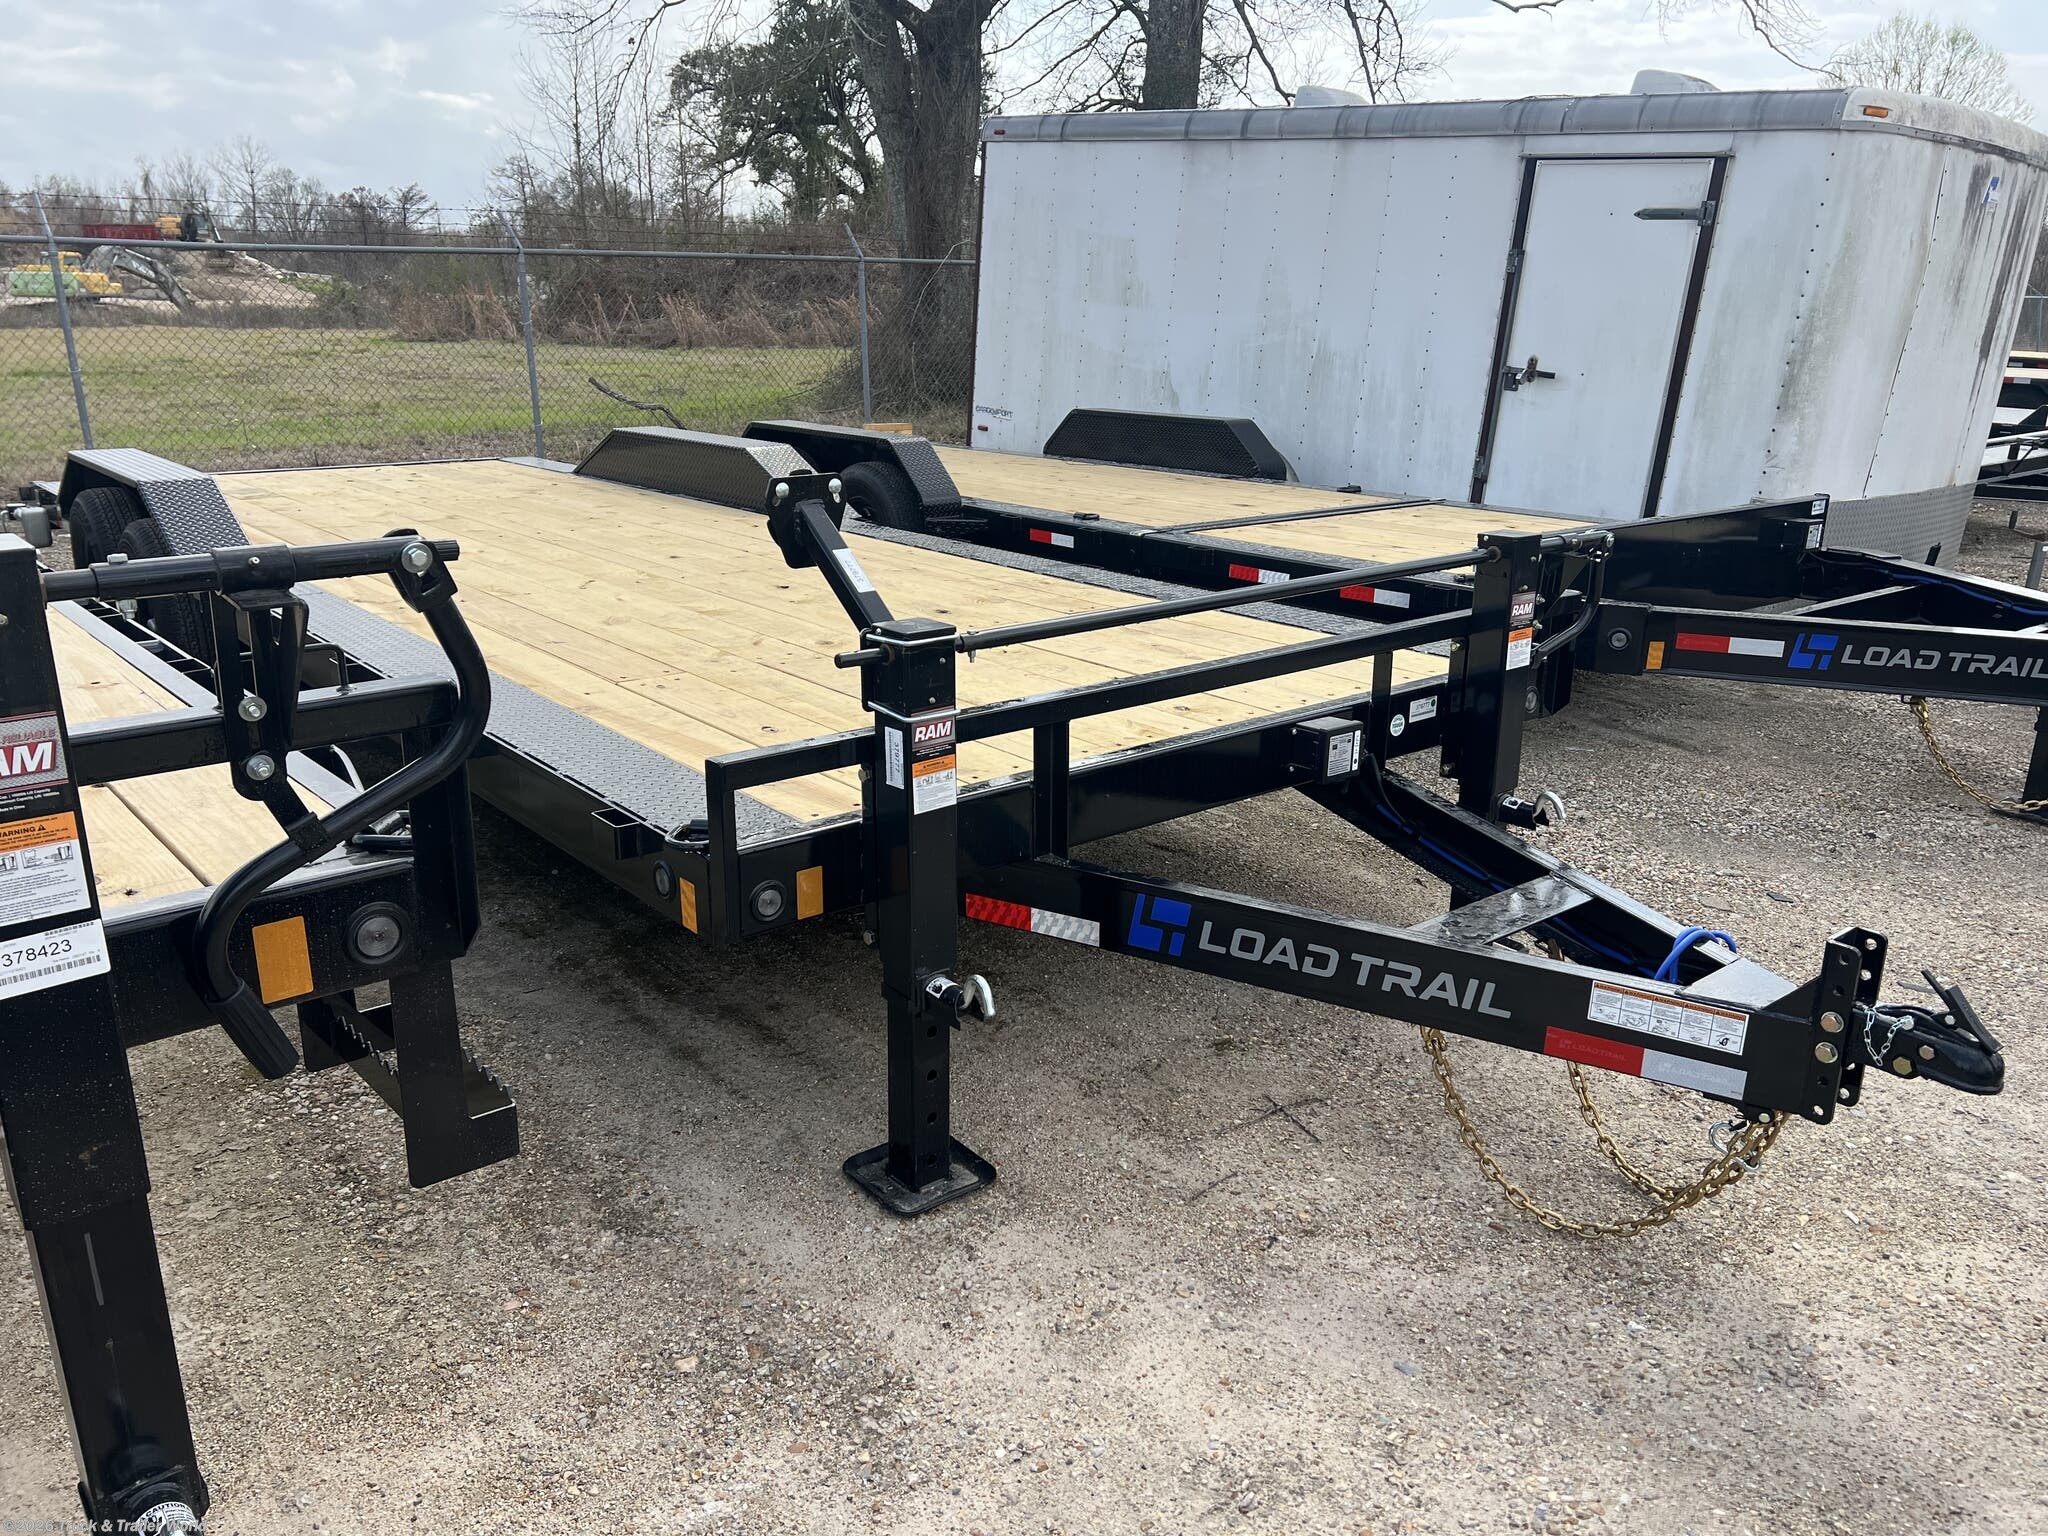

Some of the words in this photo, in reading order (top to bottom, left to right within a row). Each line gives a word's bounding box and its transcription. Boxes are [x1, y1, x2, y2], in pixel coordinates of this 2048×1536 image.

[1511, 602, 1533, 617] RAM
[1841, 644, 1942, 670] LOAD
[1948, 652, 2048, 680] TRAIL
[914, 720, 952, 743] RAM
[1, 939, 72, 967] 378423
[1199, 920, 1340, 978] LOAD
[1350, 952, 1512, 1020] TRAIL
[145, 1502, 186, 1518] CAUTION
